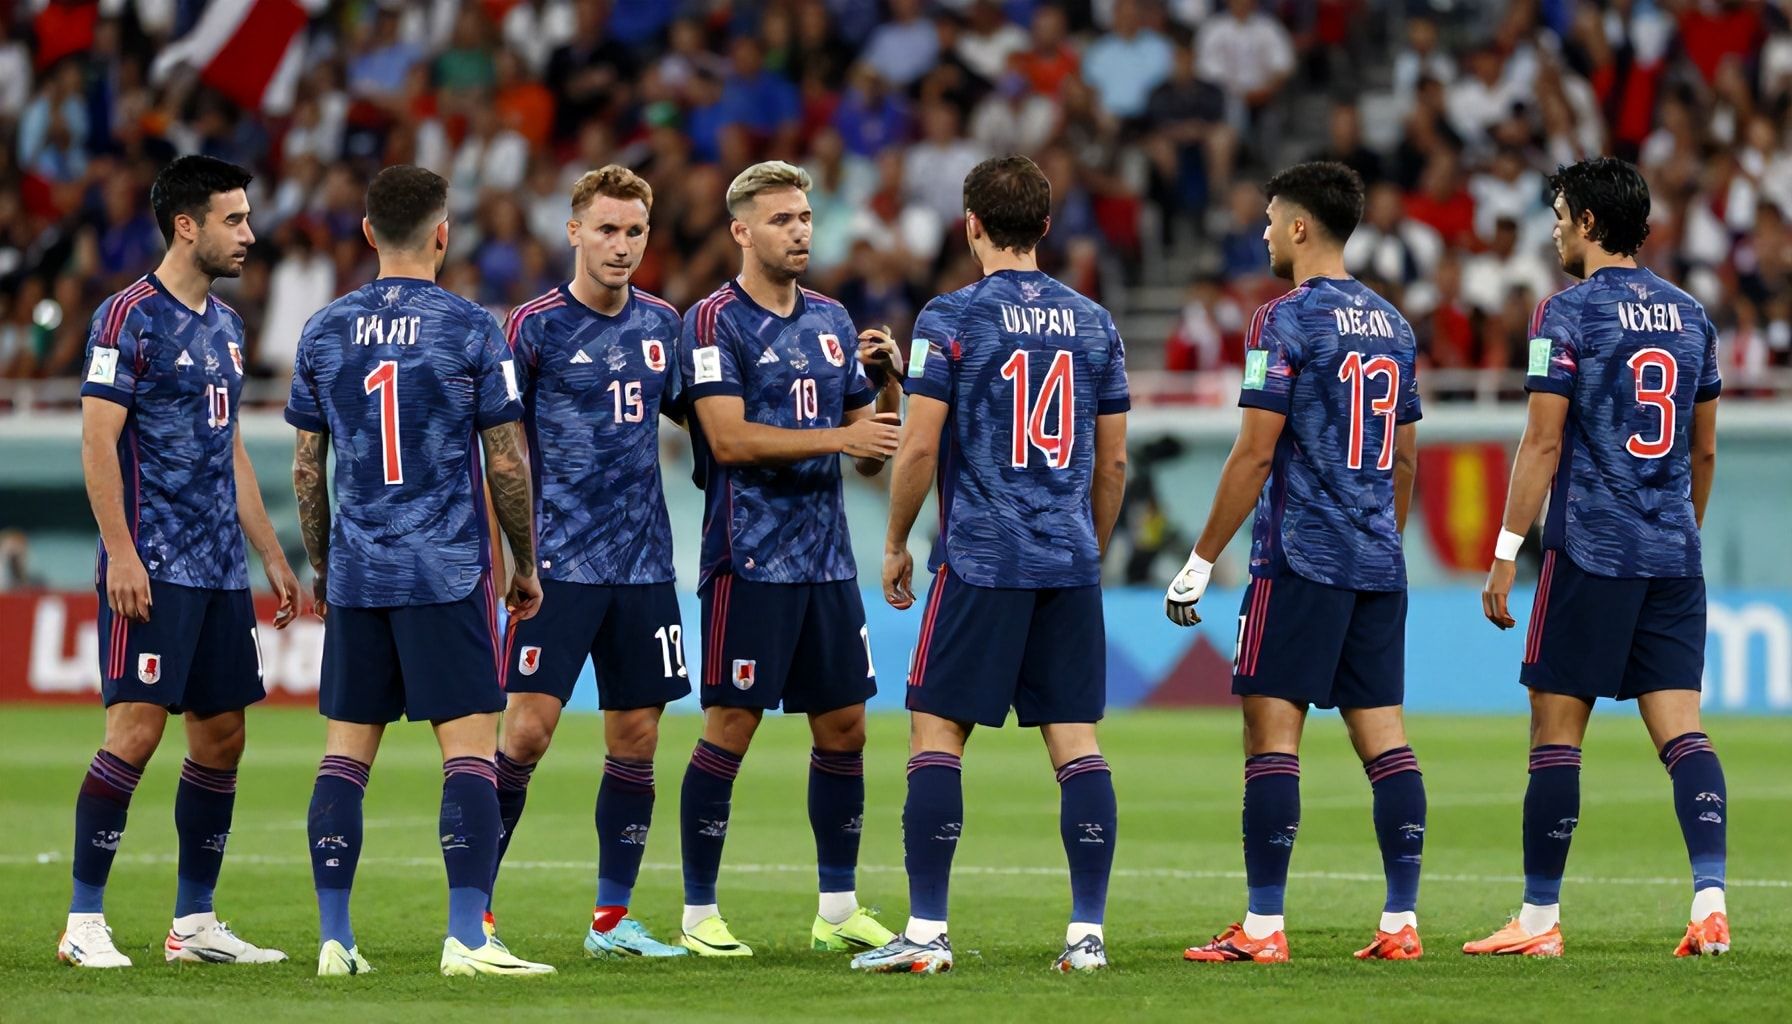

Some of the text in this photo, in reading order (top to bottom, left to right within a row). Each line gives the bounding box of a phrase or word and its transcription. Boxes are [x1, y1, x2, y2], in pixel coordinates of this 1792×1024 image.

[364, 360, 403, 485] 1
[789, 378, 818, 421] 10
[1000, 349, 1075, 469] 14
[1337, 351, 1400, 470] 13
[1626, 347, 1678, 459] 3
